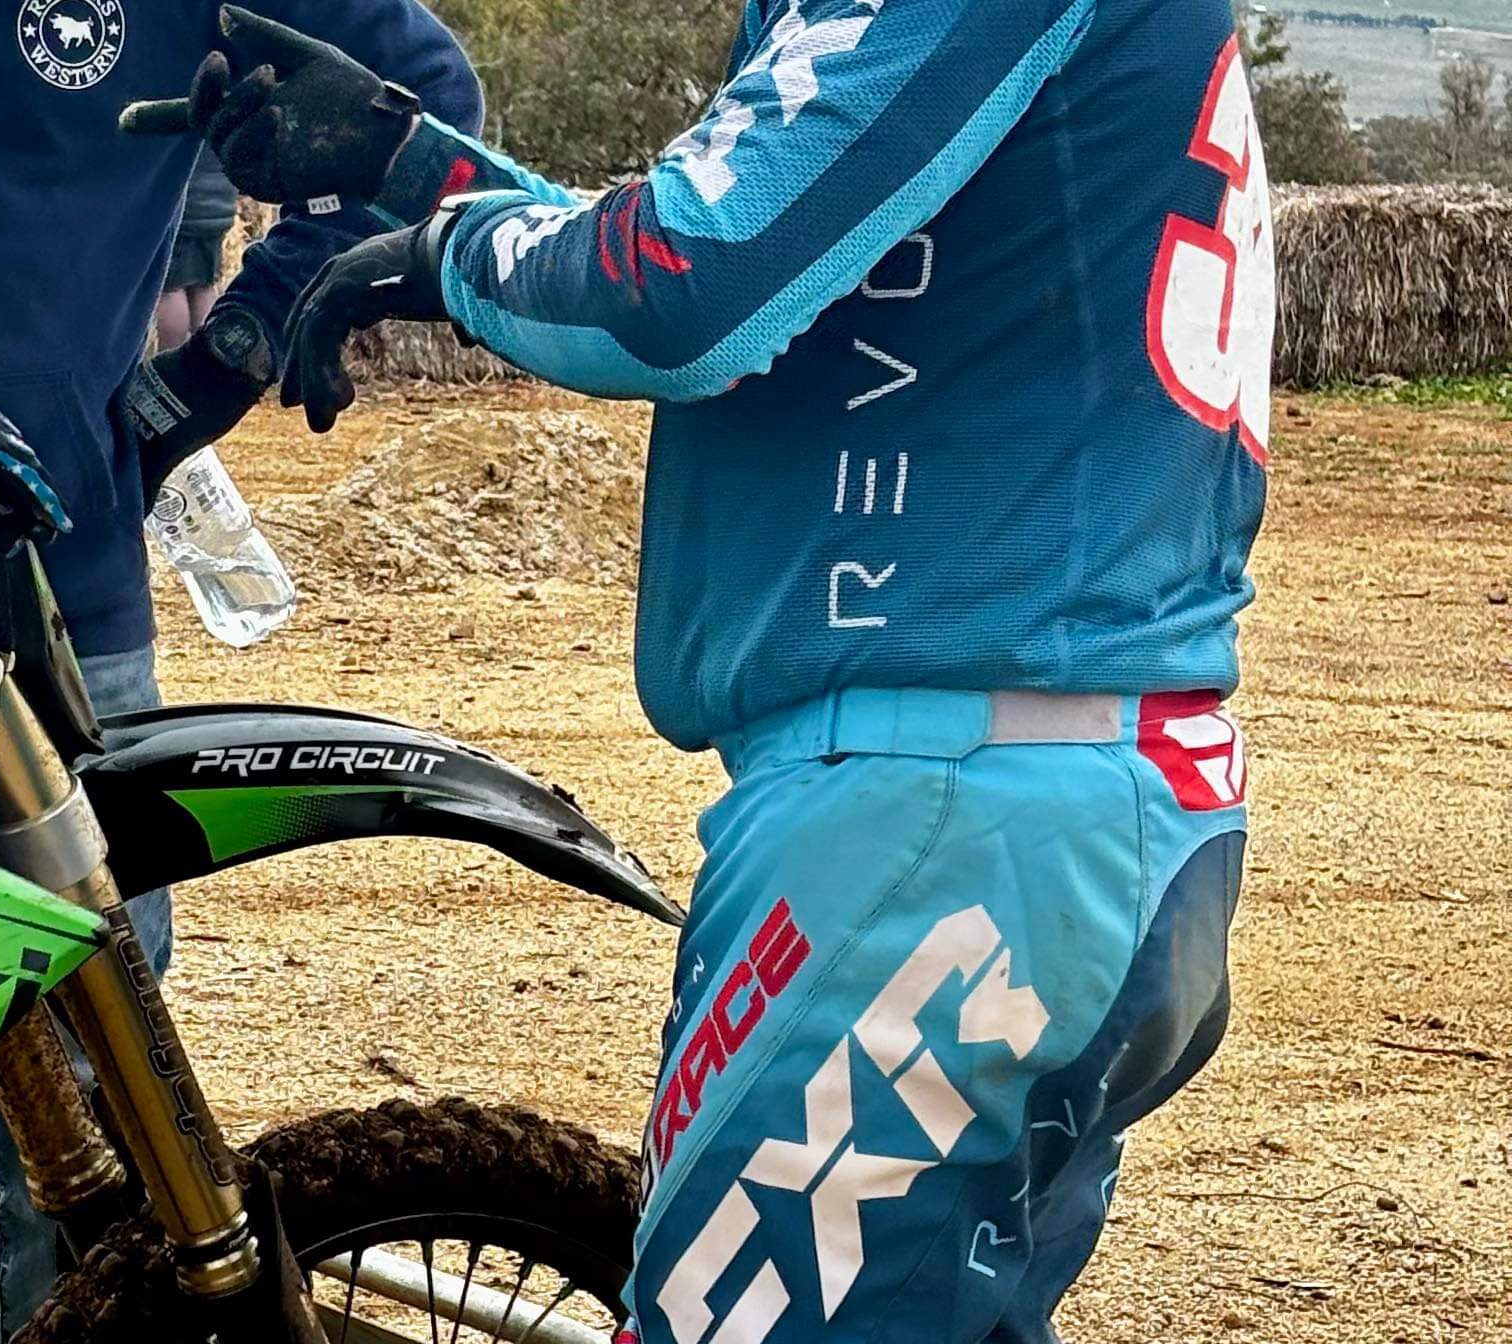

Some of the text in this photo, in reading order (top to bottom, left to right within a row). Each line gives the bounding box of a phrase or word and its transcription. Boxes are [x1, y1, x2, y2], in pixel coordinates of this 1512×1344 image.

[30, 41, 117, 85] WESTERN
[191, 746, 446, 777] PRO CIRCUIT
[653, 895, 813, 1173] RACE
